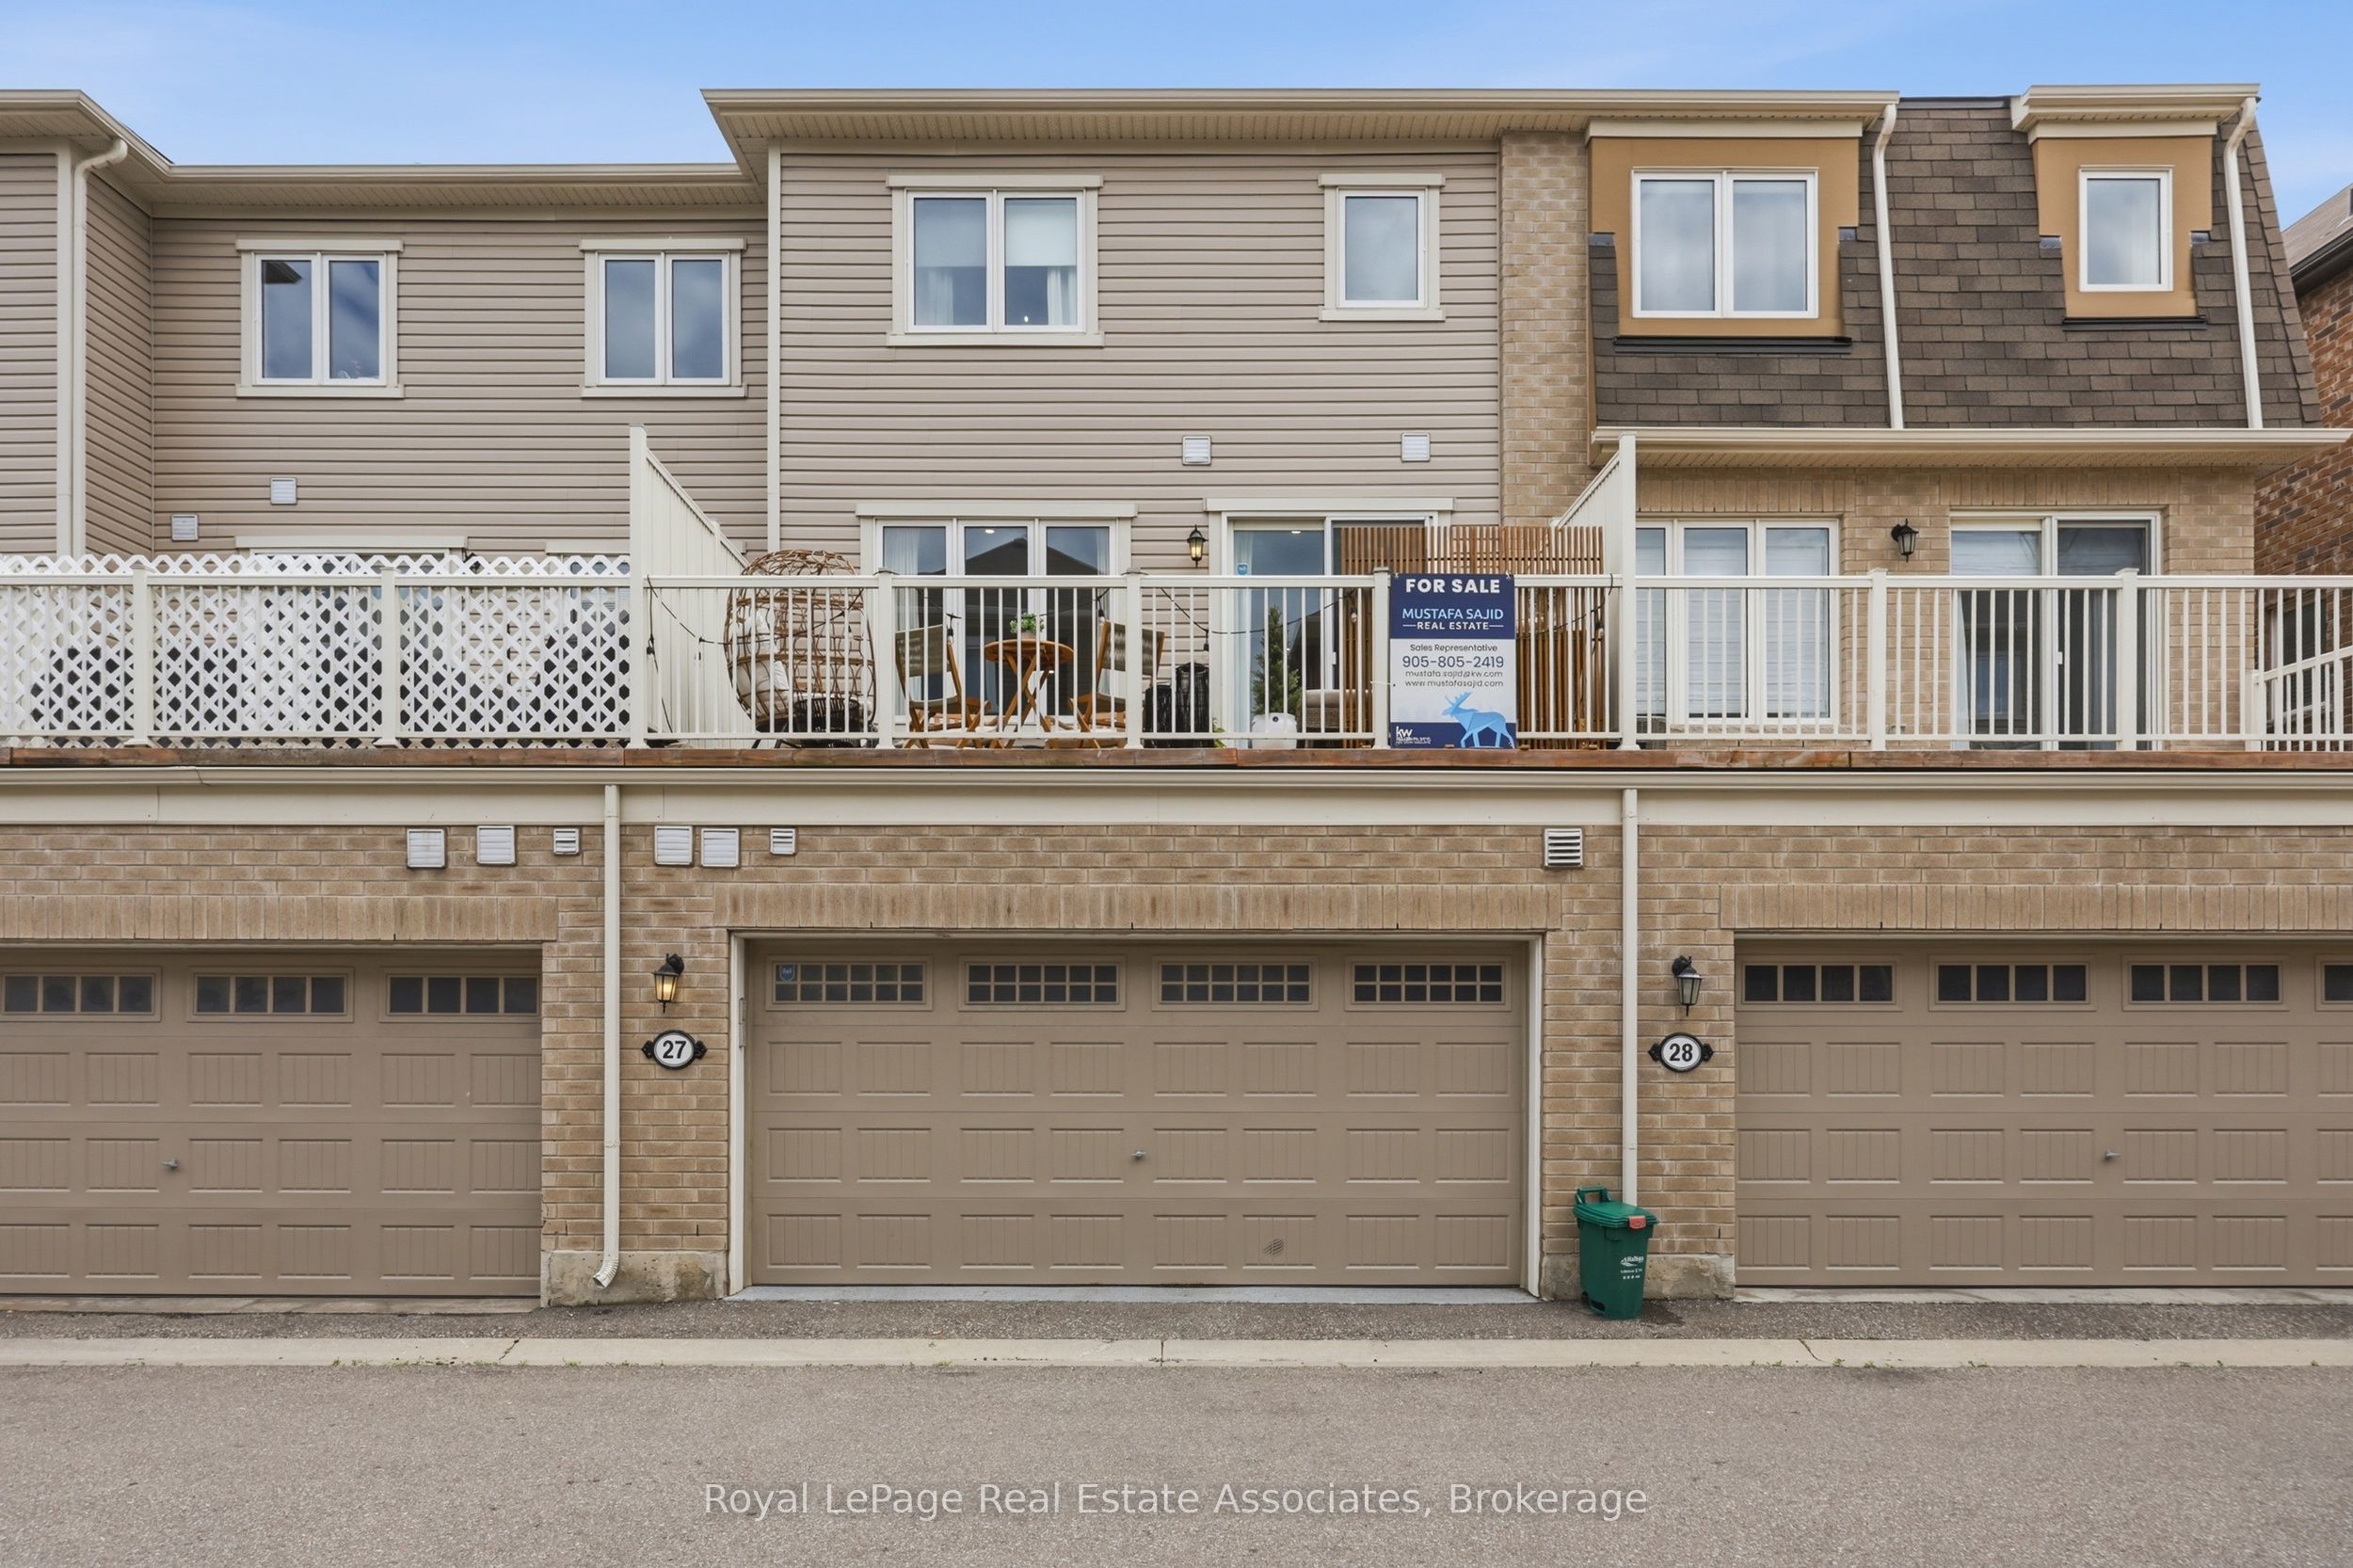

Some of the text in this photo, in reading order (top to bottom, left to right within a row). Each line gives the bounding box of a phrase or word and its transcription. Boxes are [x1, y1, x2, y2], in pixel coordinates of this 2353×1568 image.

[1405, 578, 1500, 594] FOR SALE
[1402, 608, 1504, 620] MUSTAFA SAJID
[1449, 622, 1489, 631] ESTATE
[1434, 644, 1497, 653] Representative
[1402, 656, 1504, 668] 905-805-2419
[1405, 670, 1503, 679] mustafa.sajid@kw.com
[1405, 680, 1504, 688] www.mustafasajid.com
[1396, 726, 1413, 738] kw
[663, 1040, 687, 1059] 27
[1669, 1043, 1693, 1062] 28
